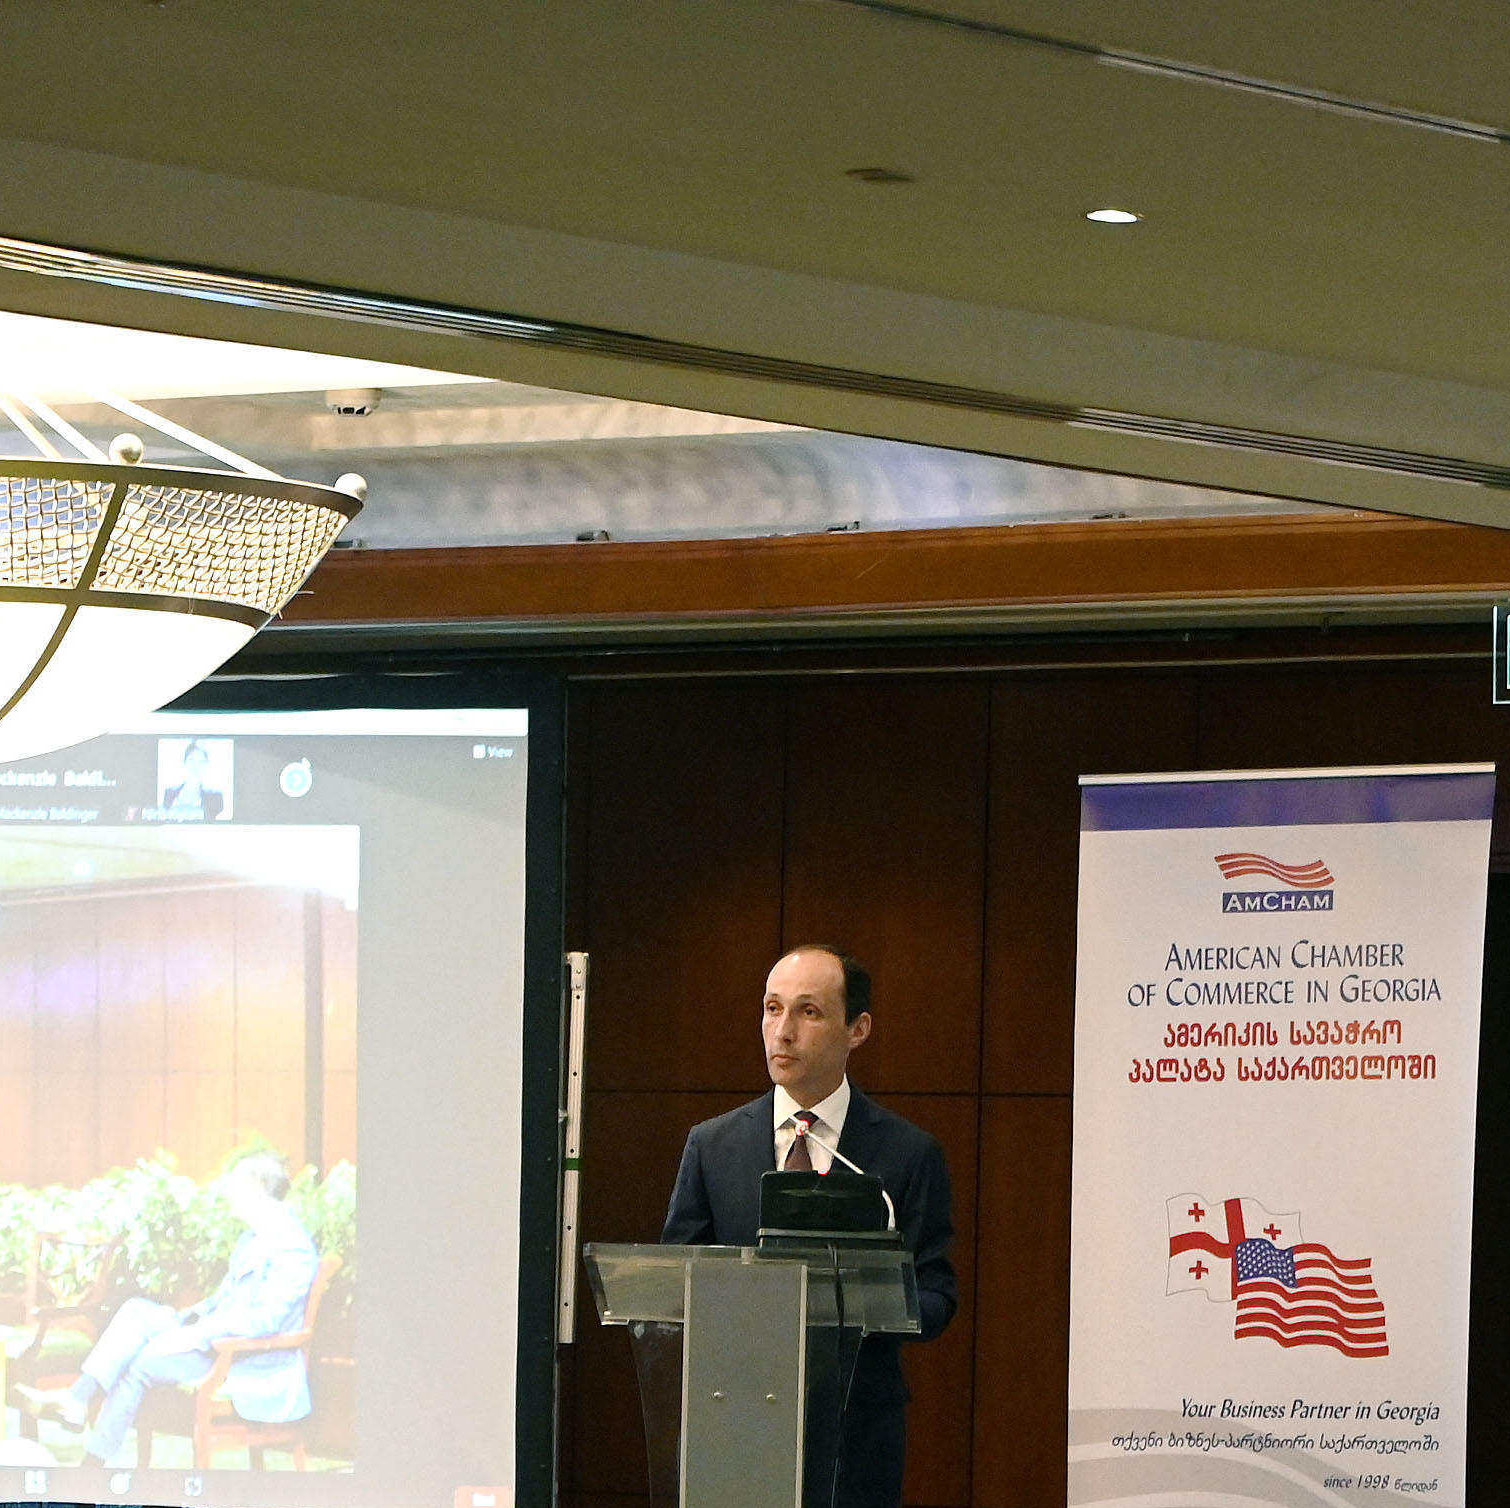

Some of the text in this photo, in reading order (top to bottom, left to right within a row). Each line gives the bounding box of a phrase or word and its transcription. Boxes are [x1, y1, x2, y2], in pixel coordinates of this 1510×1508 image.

[1164, 940, 1405, 972] AMERICAN CHAMBER
[1127, 974, 1442, 1007] OF COMMERCE IN GEORGIA
[1163, 1019, 1402, 1048] ამერიკის სავაჭრო
[1128, 1057, 1226, 1083] პალატა
[1181, 1398, 1440, 1426] Your Business Partner in Georgia
[1111, 1431, 1163, 1451] თქვენი
[1323, 1475, 1352, 1489] since
[1357, 1474, 1390, 1489] 1998
